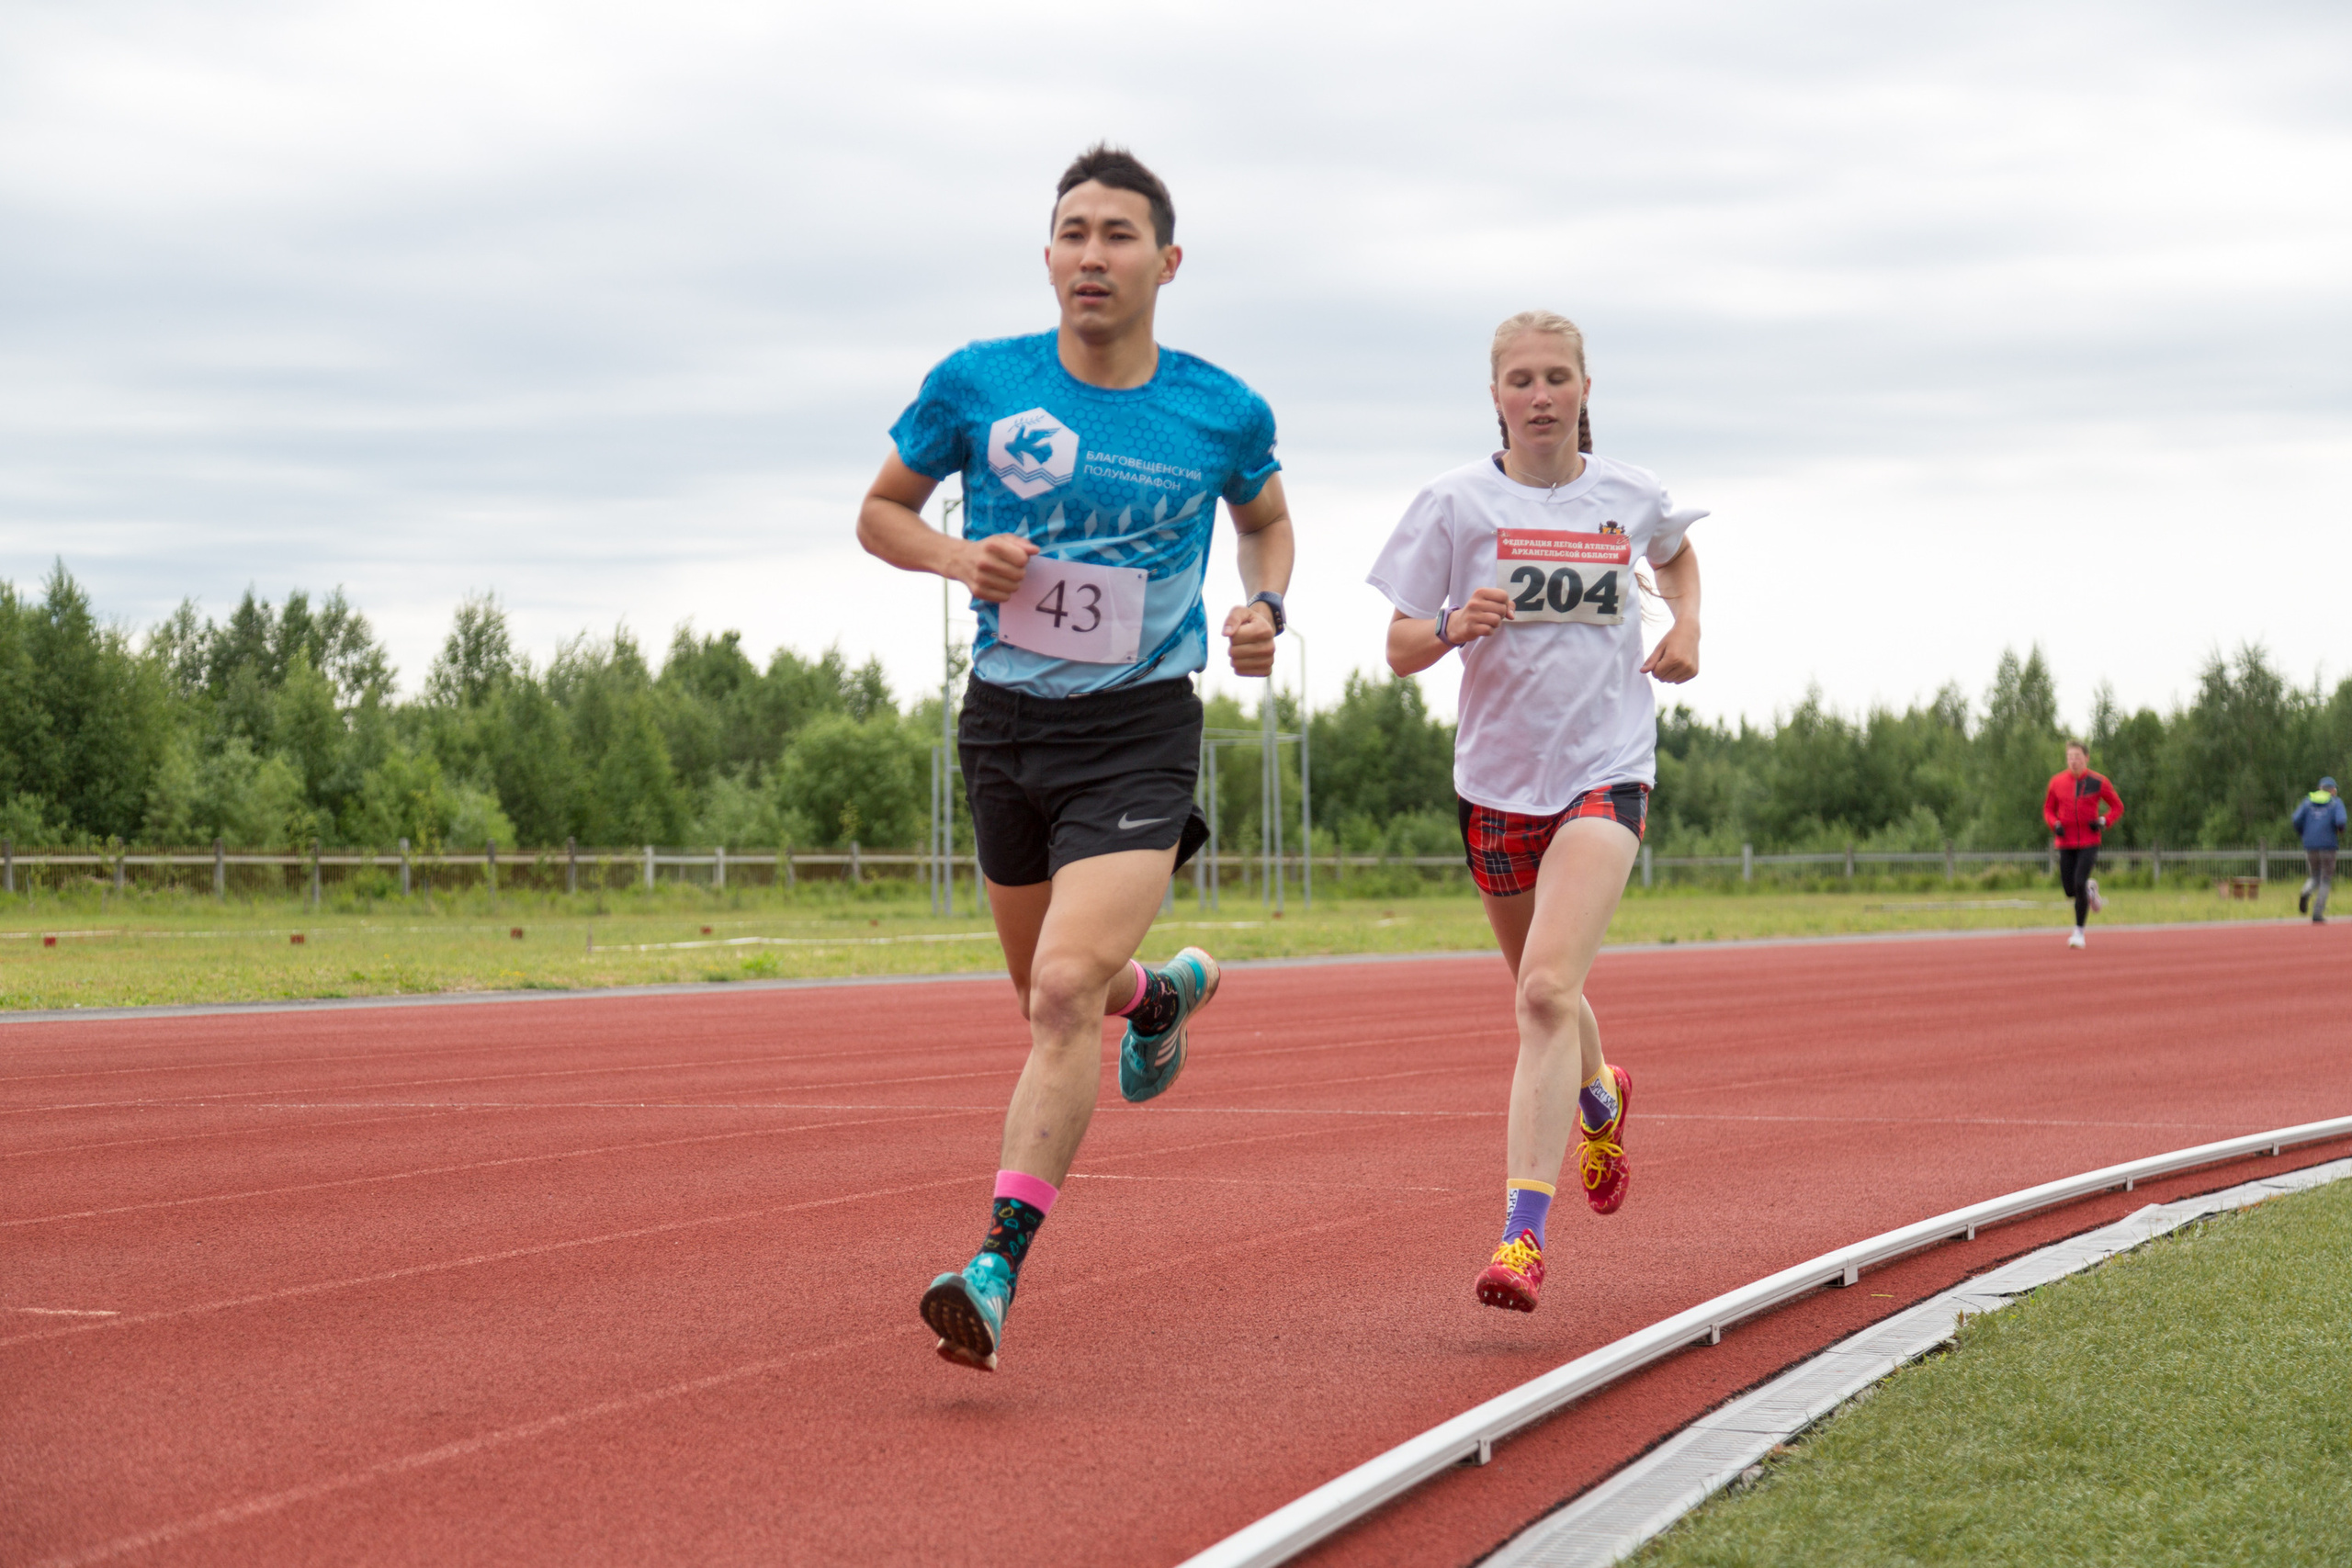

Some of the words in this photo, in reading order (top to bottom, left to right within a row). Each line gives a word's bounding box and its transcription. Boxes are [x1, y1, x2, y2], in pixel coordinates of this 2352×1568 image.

[1082, 464, 1182, 492] ПОЛУМАРАФОН
[1085, 449, 1202, 482] БЛАГОВЕЩЕНСКИЙ
[1502, 537, 1552, 548] ФЕДЕРАЦИЯ
[1553, 539, 1583, 550] ЛЕГКОЙ
[1584, 542, 1627, 551] АТЛЕТИКИ
[1510, 547, 1580, 558] АРХАНГЕЛЬСКОЙ
[1581, 551, 1620, 559] ОБЛАСТИ
[1510, 565, 1620, 615] 204
[1035, 579, 1102, 633] 43
